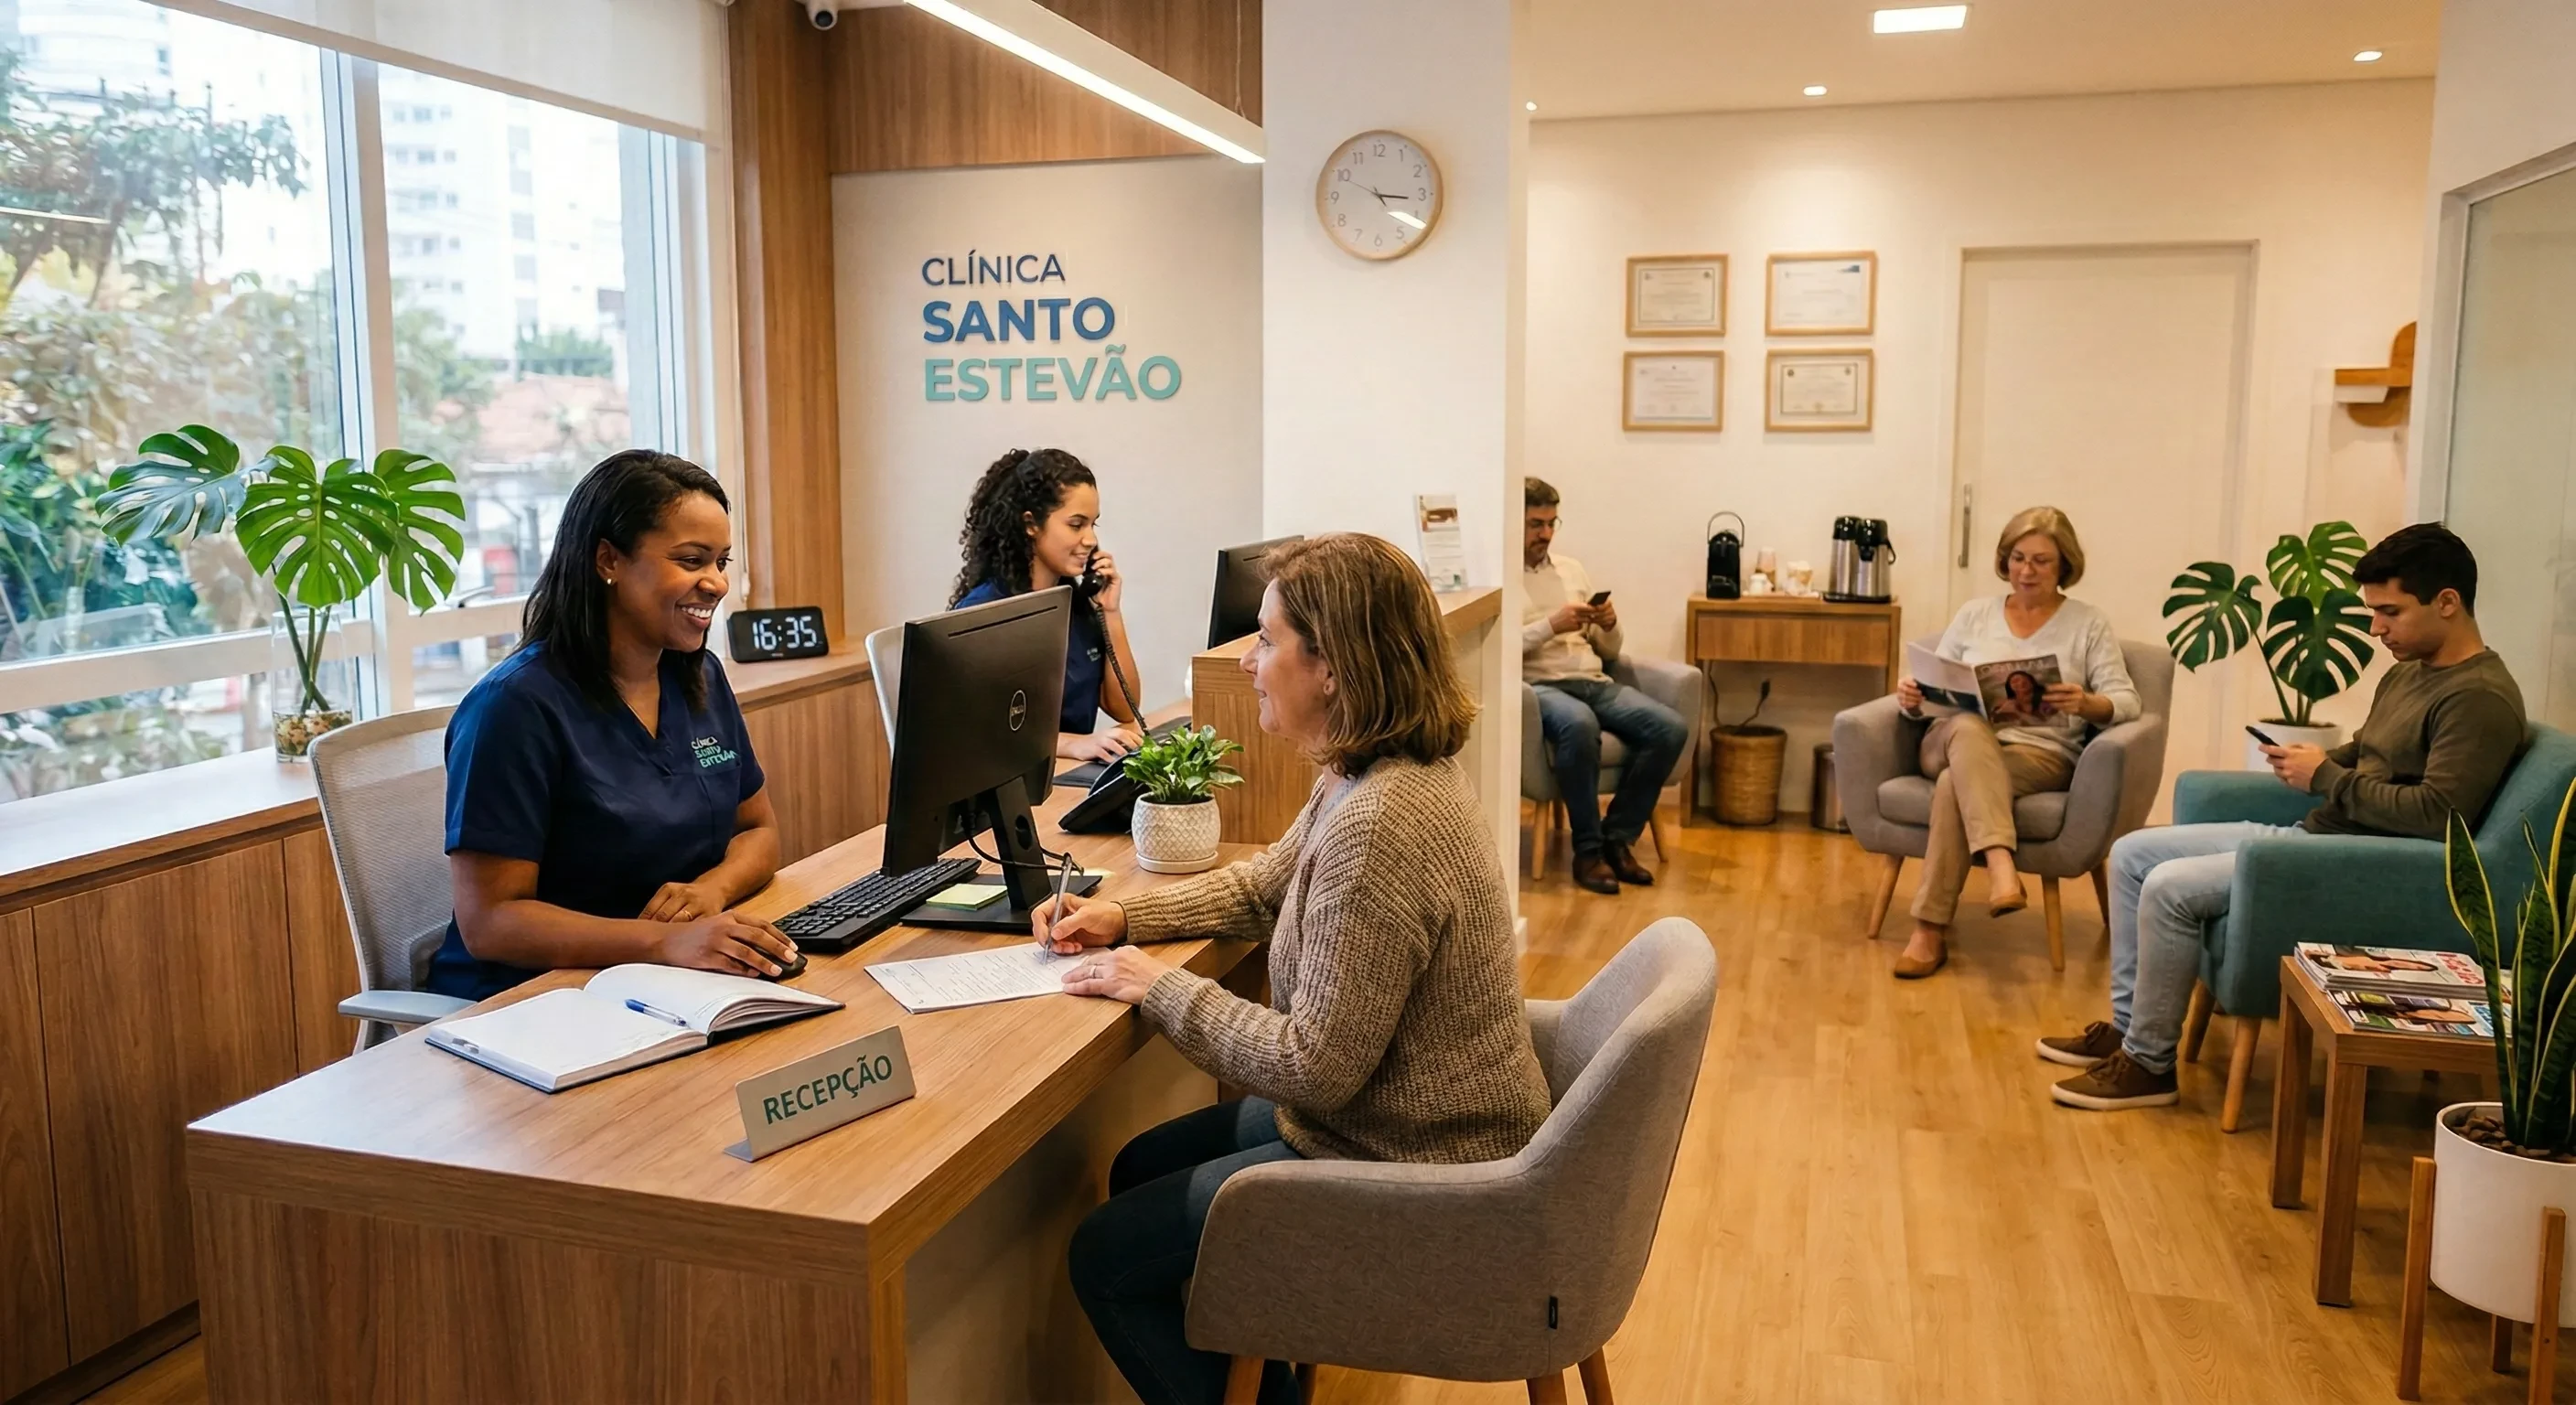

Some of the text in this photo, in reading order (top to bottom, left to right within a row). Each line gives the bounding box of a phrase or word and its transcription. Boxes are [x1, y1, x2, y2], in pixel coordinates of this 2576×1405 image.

[1373, 144, 1386, 157] 12
[1399, 149, 1404, 162] 1
[1353, 152, 1364, 165] 11
[1337, 168, 1351, 182] 10
[1413, 165, 1422, 177] 2
[1330, 191, 1339, 204] 9
[1418, 188, 1426, 201] 3
[1337, 214, 1347, 227] 8
[1354, 229, 1363, 241] 7
[1374, 233, 1383, 247] 6
[1396, 227, 1405, 240] 5
[921, 249, 1066, 286] CLÍNICA
[922, 297, 1115, 343] SANTO
[924, 344, 1182, 402] ESTEVÃO
[752, 616, 817, 650] 16:35
[763, 1055, 893, 1125] RECEPÇÃO
